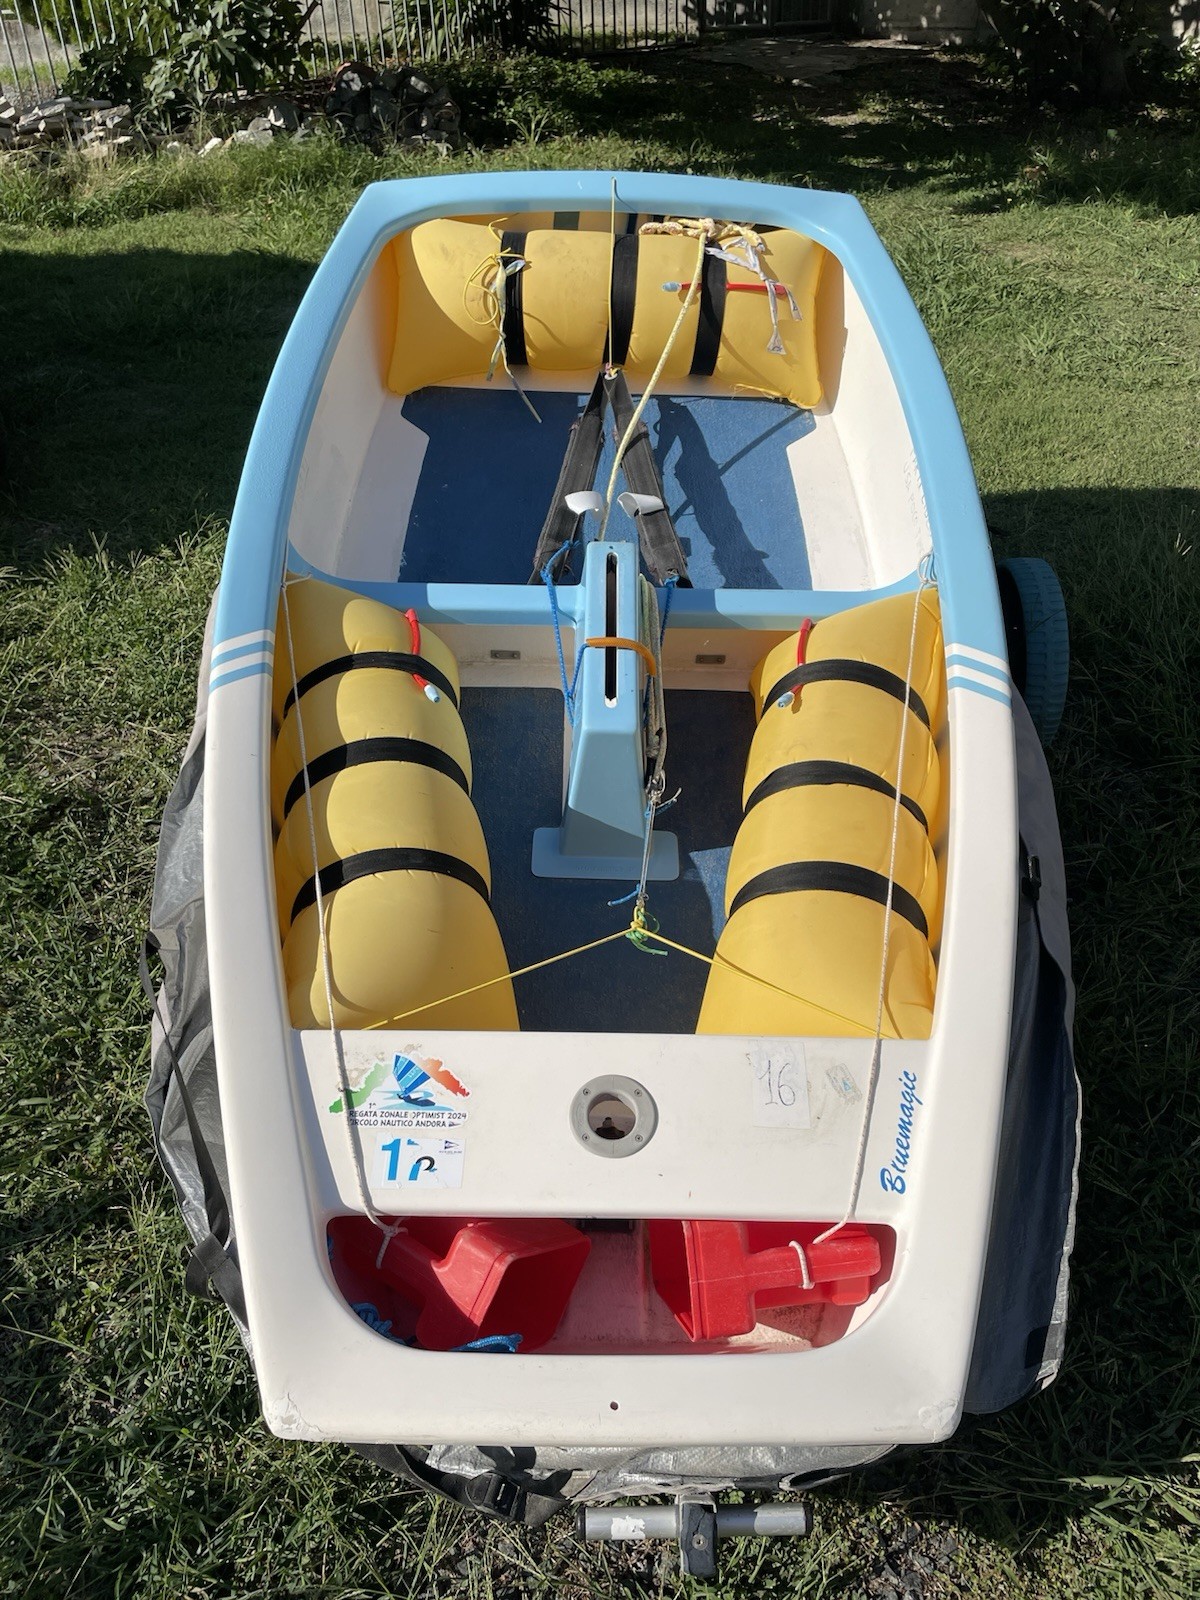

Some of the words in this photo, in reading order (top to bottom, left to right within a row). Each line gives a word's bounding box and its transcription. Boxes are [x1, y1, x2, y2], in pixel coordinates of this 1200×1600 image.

[758, 1060, 796, 1106] 16
[349, 1110, 378, 1118] REGATA
[380, 1110, 409, 1118] ZONALE
[447, 1112, 467, 1120] 2024
[380, 1119, 413, 1127] NAUTICO
[415, 1120, 446, 1128] ANDORA
